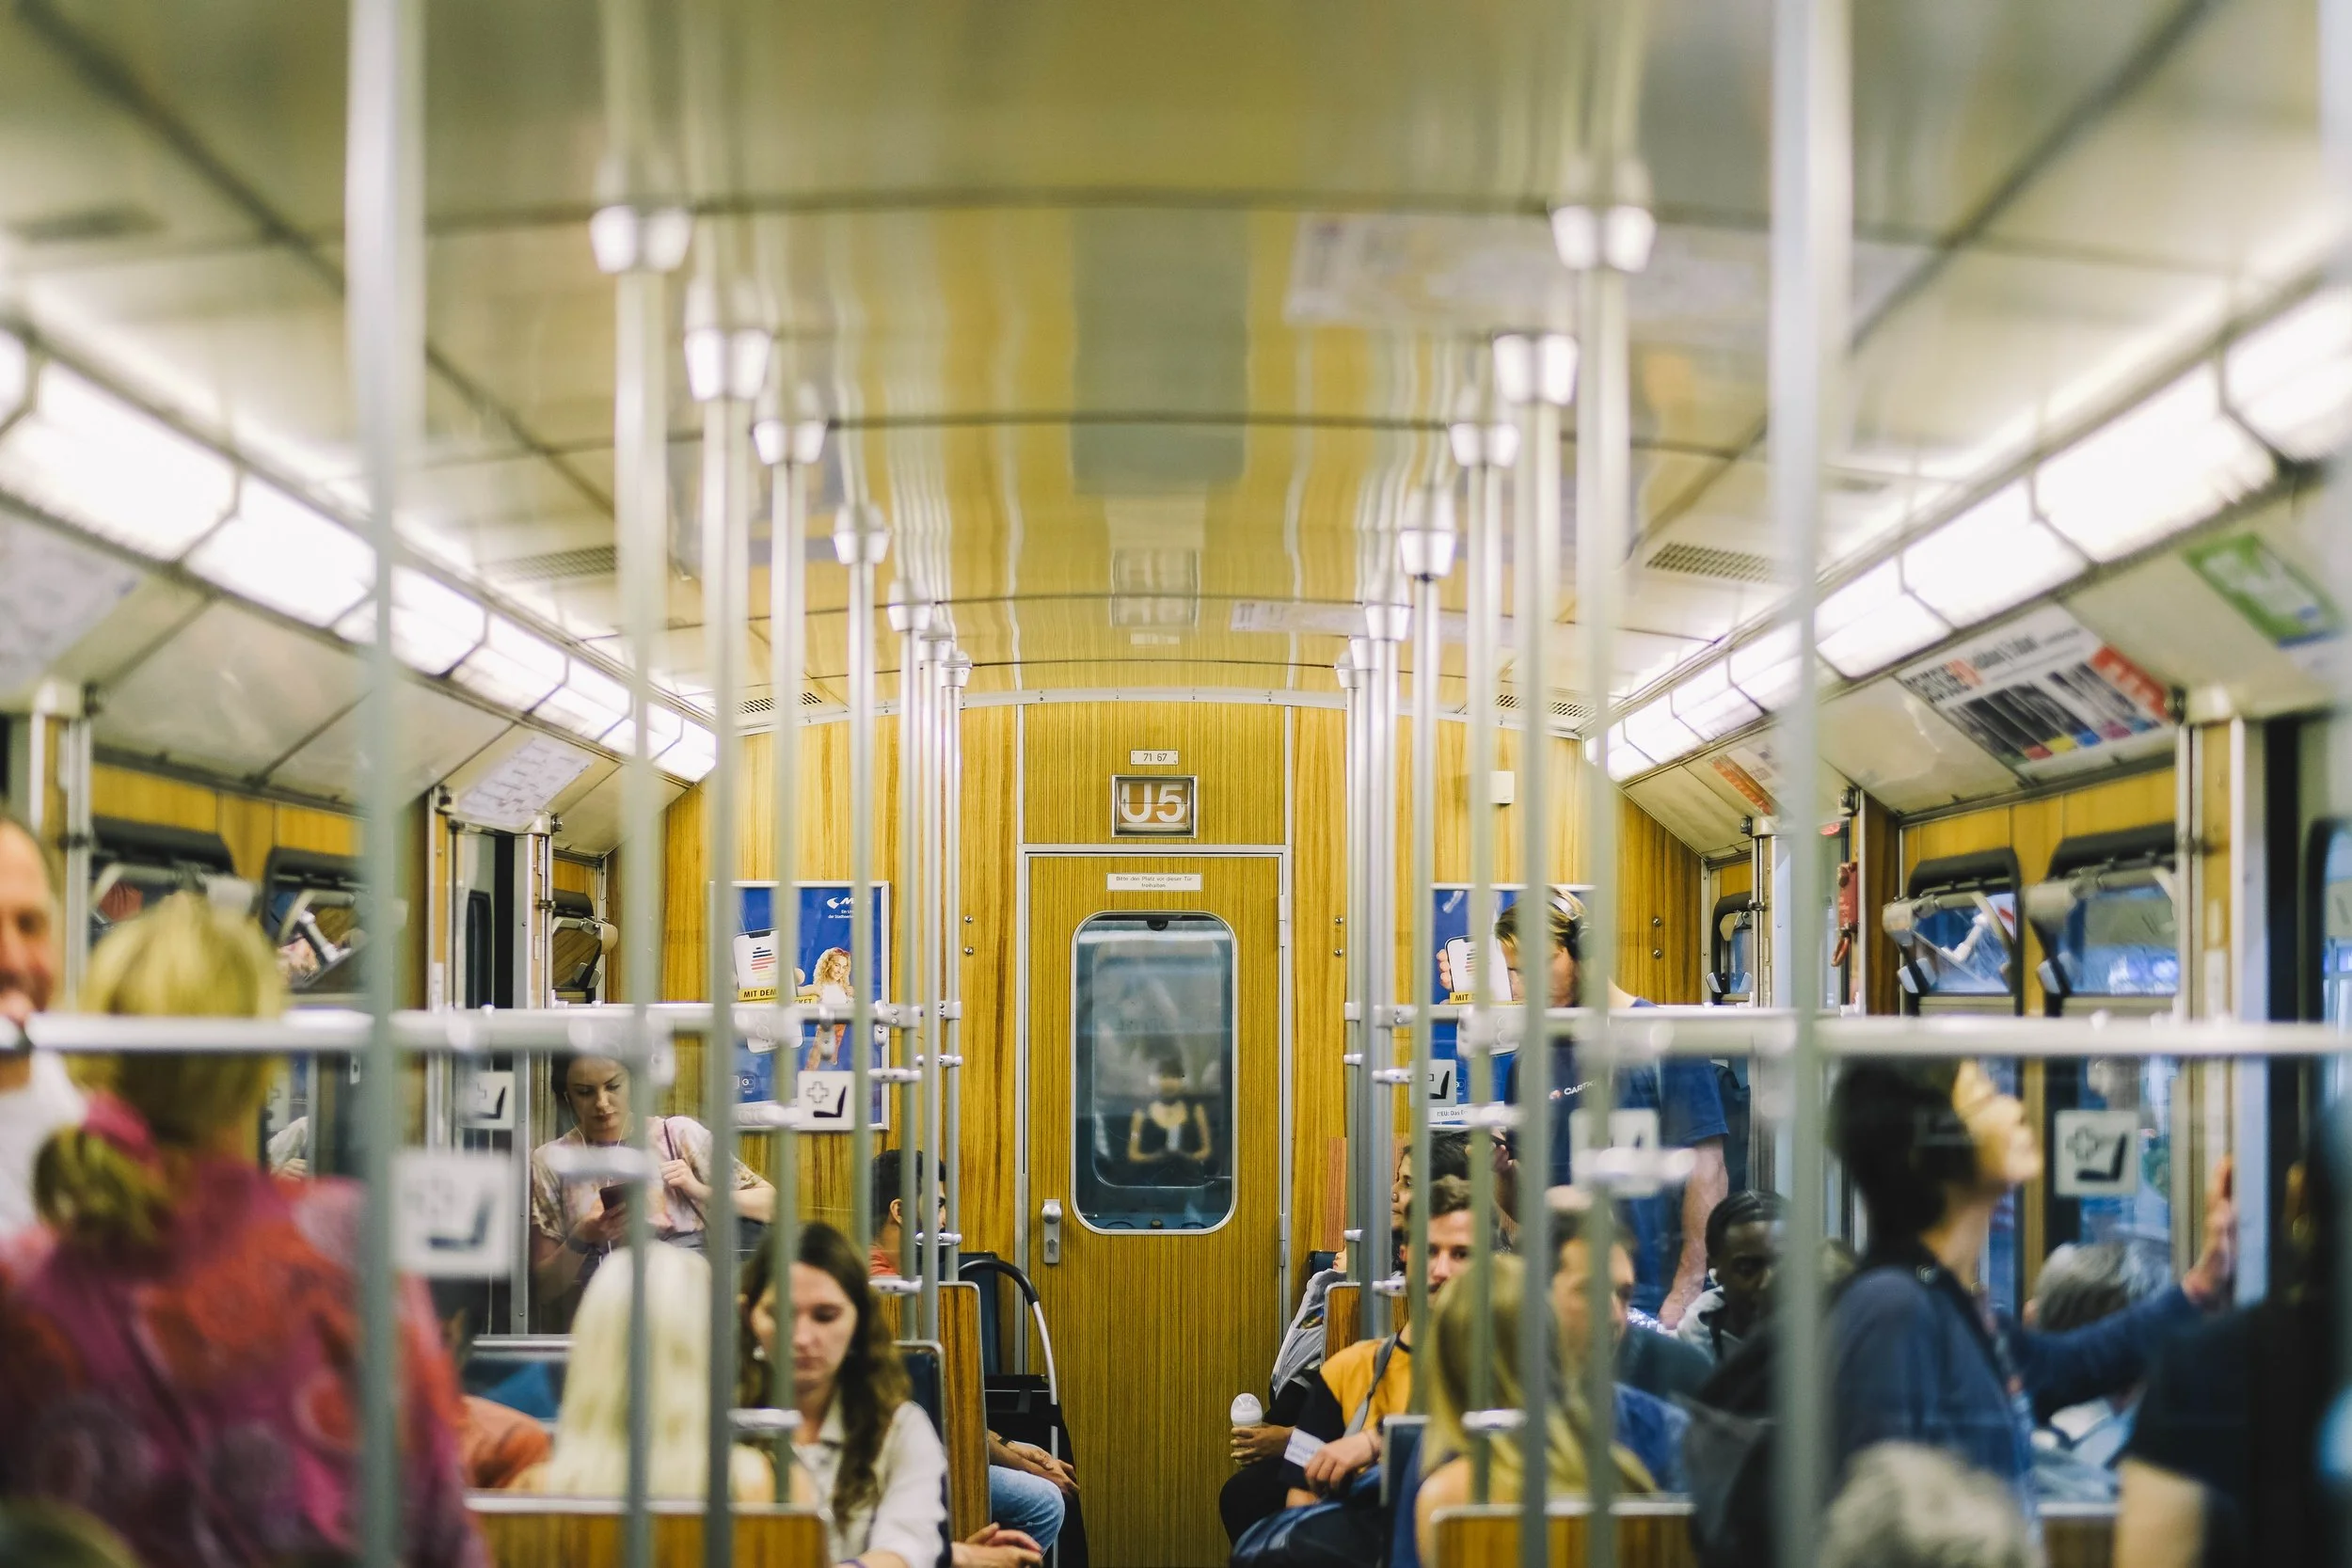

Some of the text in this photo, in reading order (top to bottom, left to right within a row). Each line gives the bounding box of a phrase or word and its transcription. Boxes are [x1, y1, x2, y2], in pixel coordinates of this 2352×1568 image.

[1143, 752, 1168, 762] 71 67
[1120, 783, 1185, 823] U5
[759, 989, 777, 997] DEM
[1454, 993, 1469, 1002] MIT
